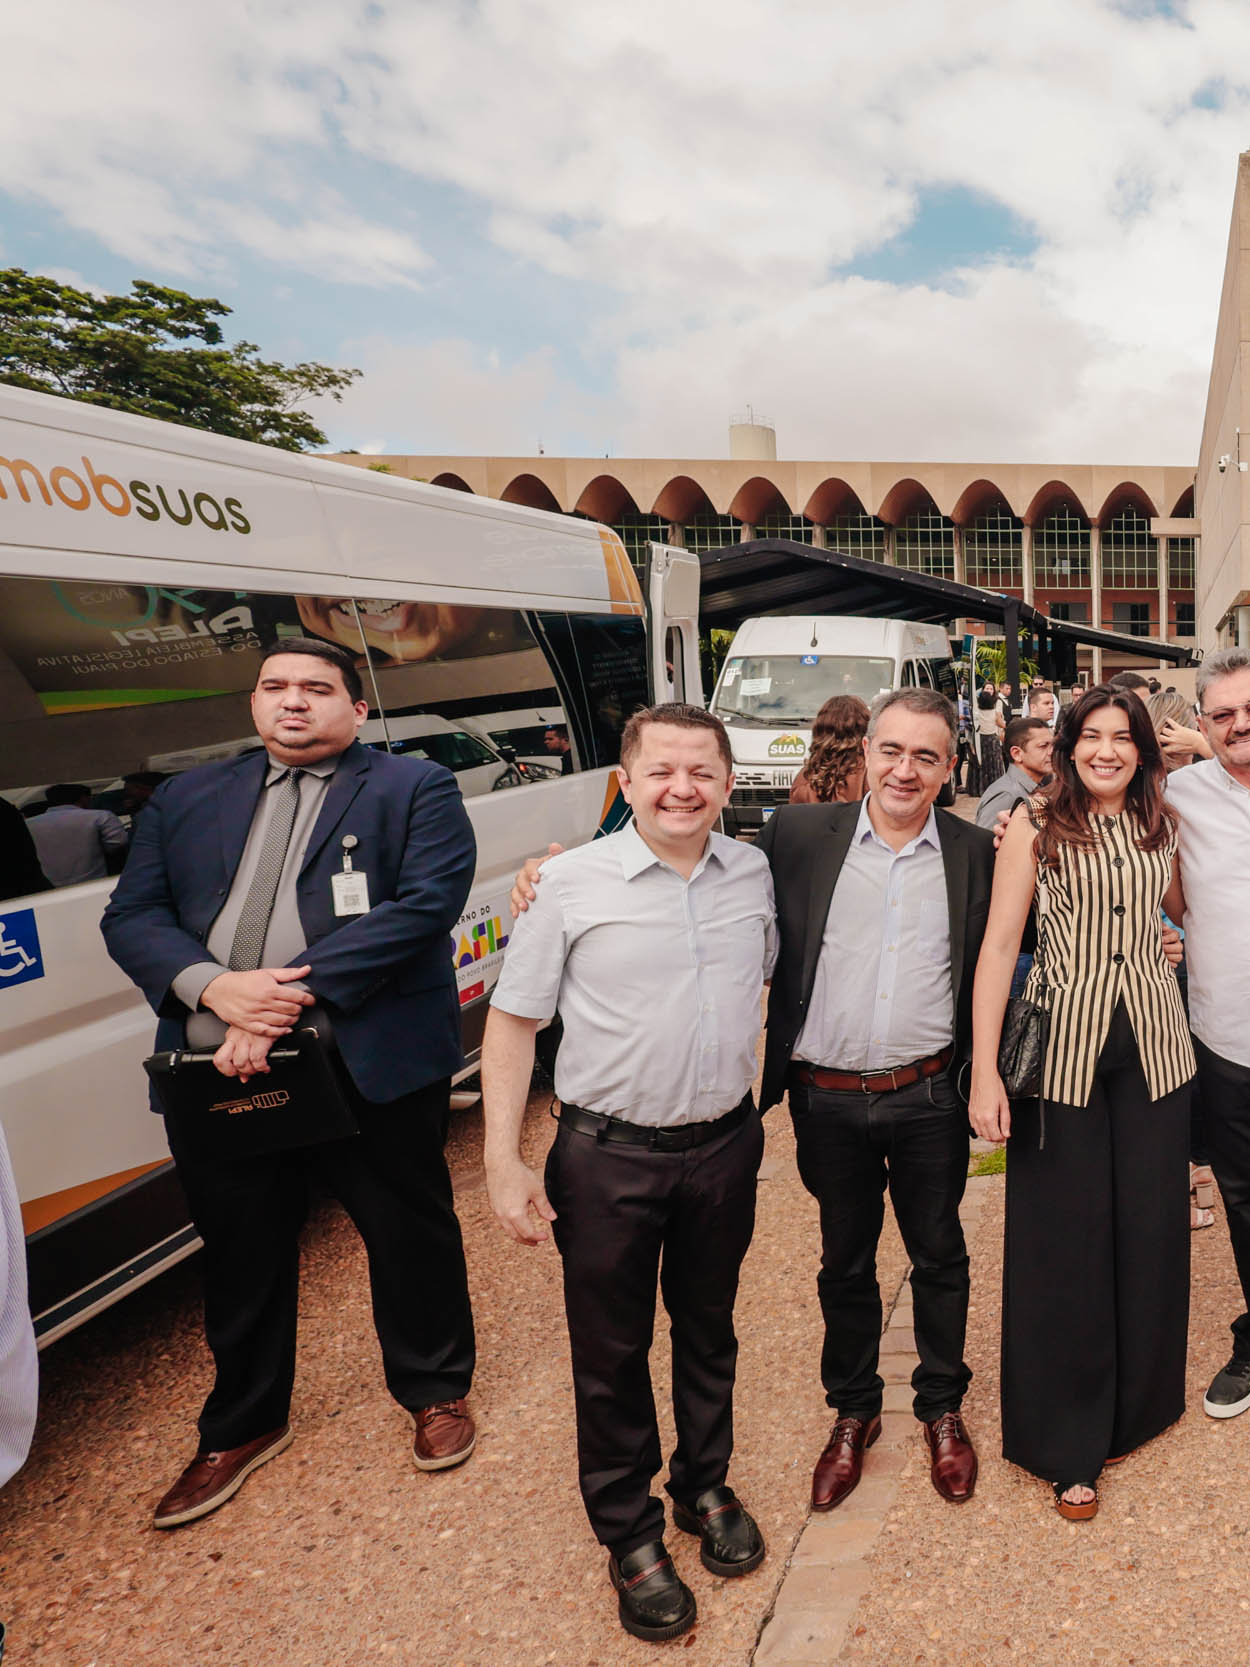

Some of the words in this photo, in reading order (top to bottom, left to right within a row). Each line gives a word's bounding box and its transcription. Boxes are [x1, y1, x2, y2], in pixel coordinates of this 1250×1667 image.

[0, 456, 251, 534] mobsuas
[770, 744, 804, 755] SUAS
[481, 905, 490, 916] DO
